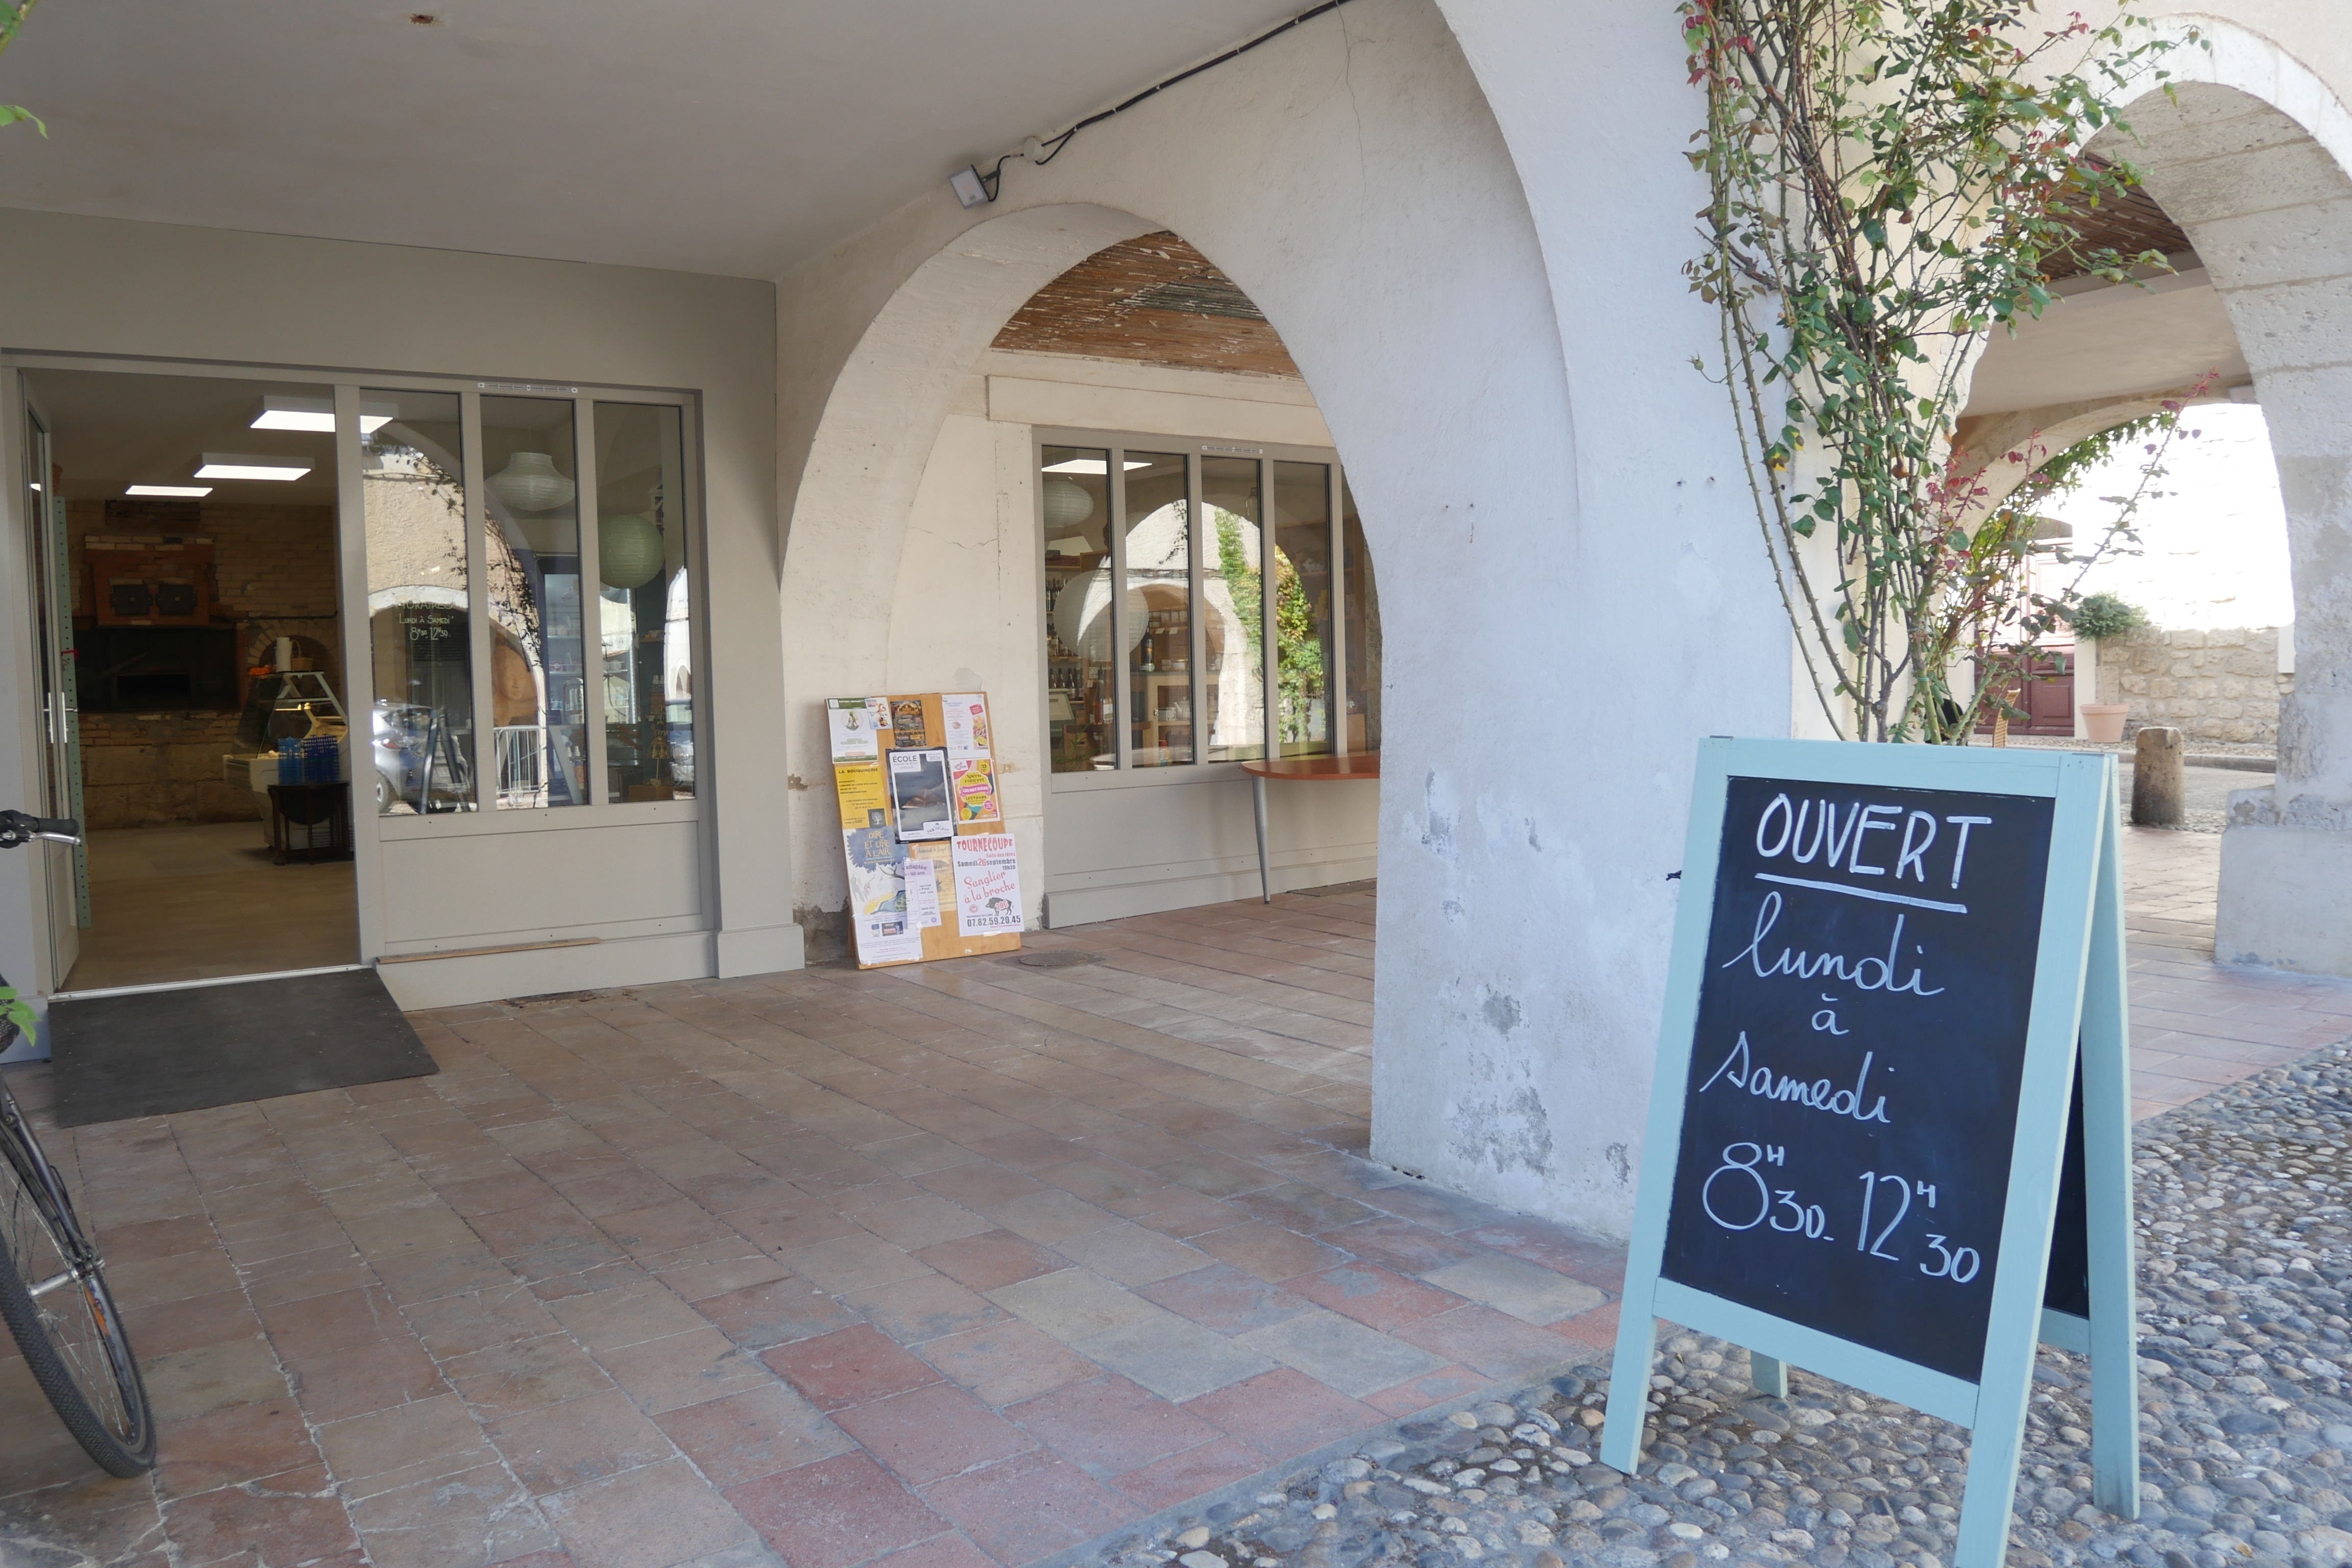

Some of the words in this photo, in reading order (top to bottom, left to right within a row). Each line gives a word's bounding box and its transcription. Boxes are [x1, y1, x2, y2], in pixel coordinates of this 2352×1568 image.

[893, 754, 917, 763] ÉCOLE
[868, 830, 884, 839] DIRE
[864, 840, 873, 849] ET
[875, 839, 890, 848] LIRE
[957, 837, 1013, 852] TOURNECOUPE
[1754, 793, 1992, 890] OUVERT
[977, 858, 987, 867] 26
[986, 858, 1016, 866] septembre
[964, 870, 1007, 889] Sanglier
[964, 895, 971, 904] à
[970, 889, 983, 901] la
[982, 879, 1016, 898] broche
[967, 915, 1021, 927] 07.82.59.20.45
[1721, 891, 1945, 996] lundi
